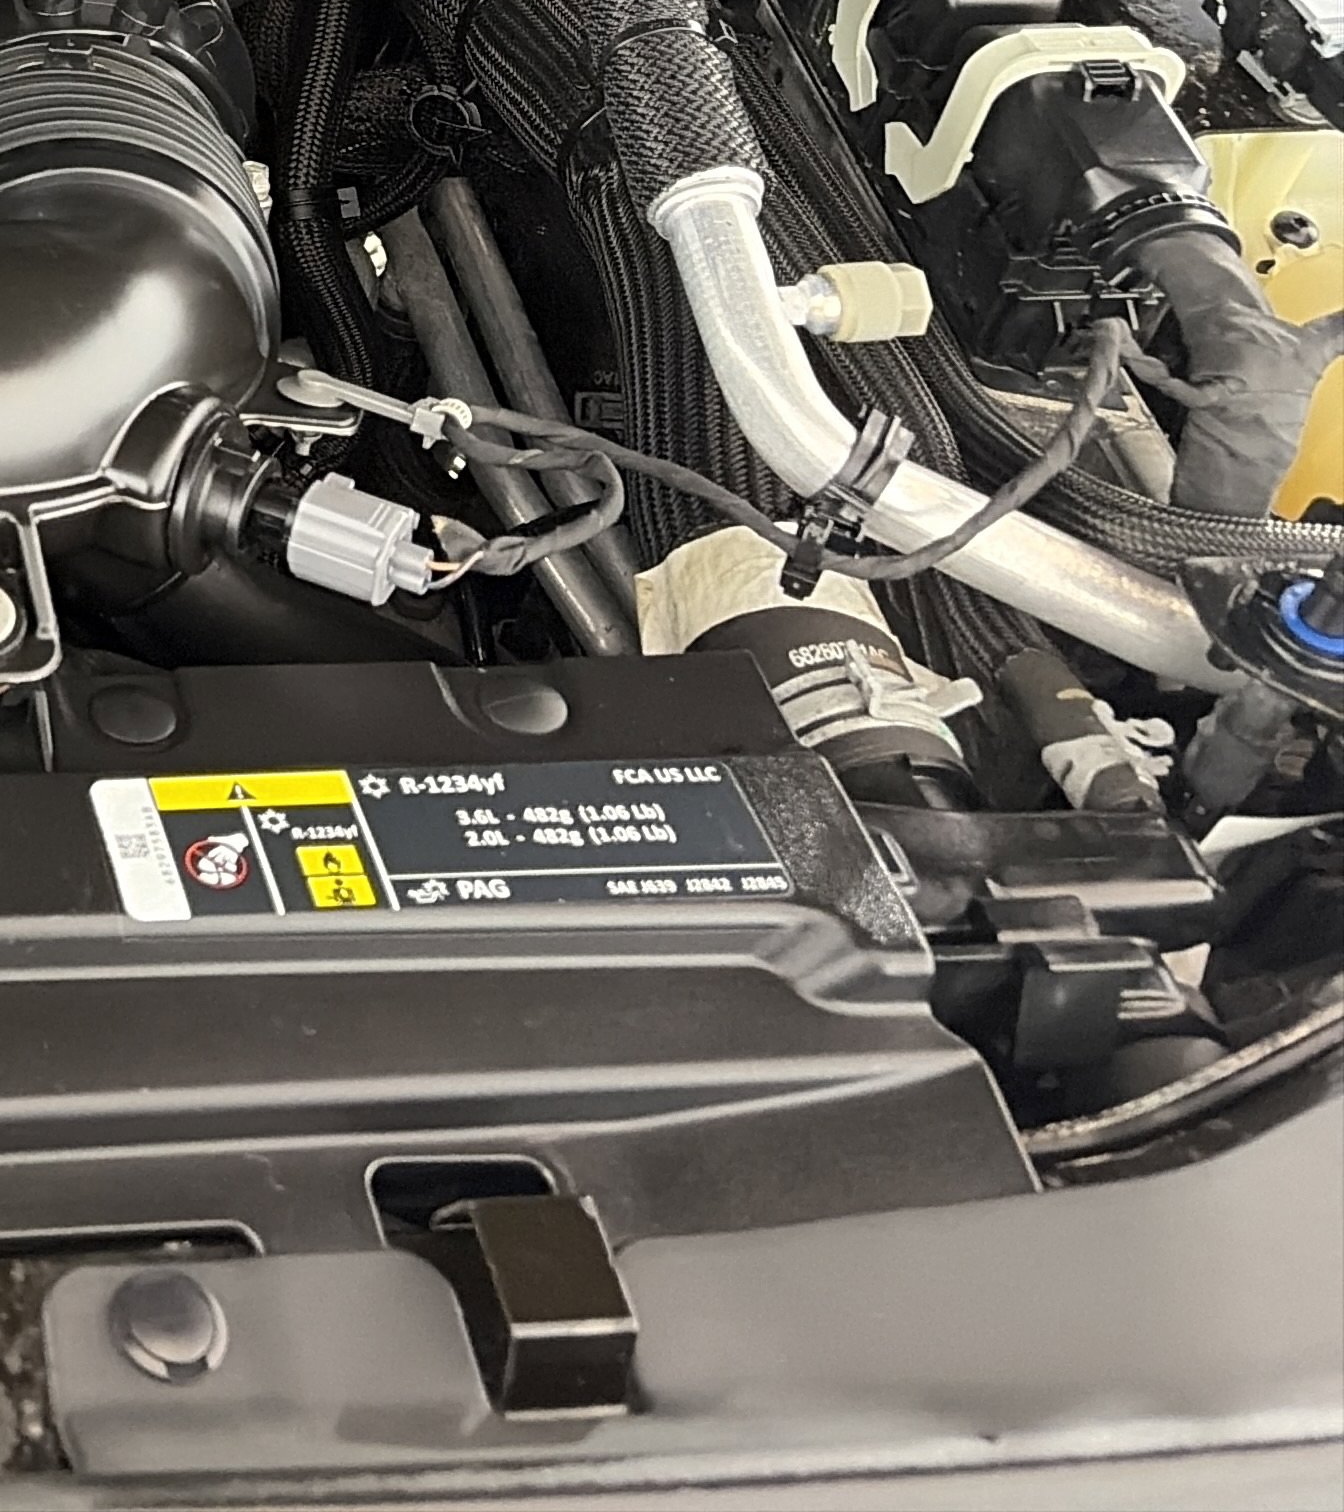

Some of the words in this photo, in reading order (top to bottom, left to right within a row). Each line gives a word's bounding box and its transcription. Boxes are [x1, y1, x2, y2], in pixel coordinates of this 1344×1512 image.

[399, 773, 506, 796] R-1234yf
[612, 769, 651, 785] FCA
[653, 768, 682, 784] US
[683, 766, 722, 783] LLC
[455, 808, 500, 826] 3.6L
[522, 806, 573, 826] 482g
[578, 804, 630, 824] (1.06
[632, 802, 667, 824] Lb)
[291, 825, 359, 840] R-1234yf
[464, 829, 510, 847] 2.0L
[532, 827, 584, 848] 482g
[588, 825, 641, 846] (1.06
[643, 823, 677, 844] Lb)
[455, 879, 511, 900] PAG
[606, 881, 638, 895] SAE
